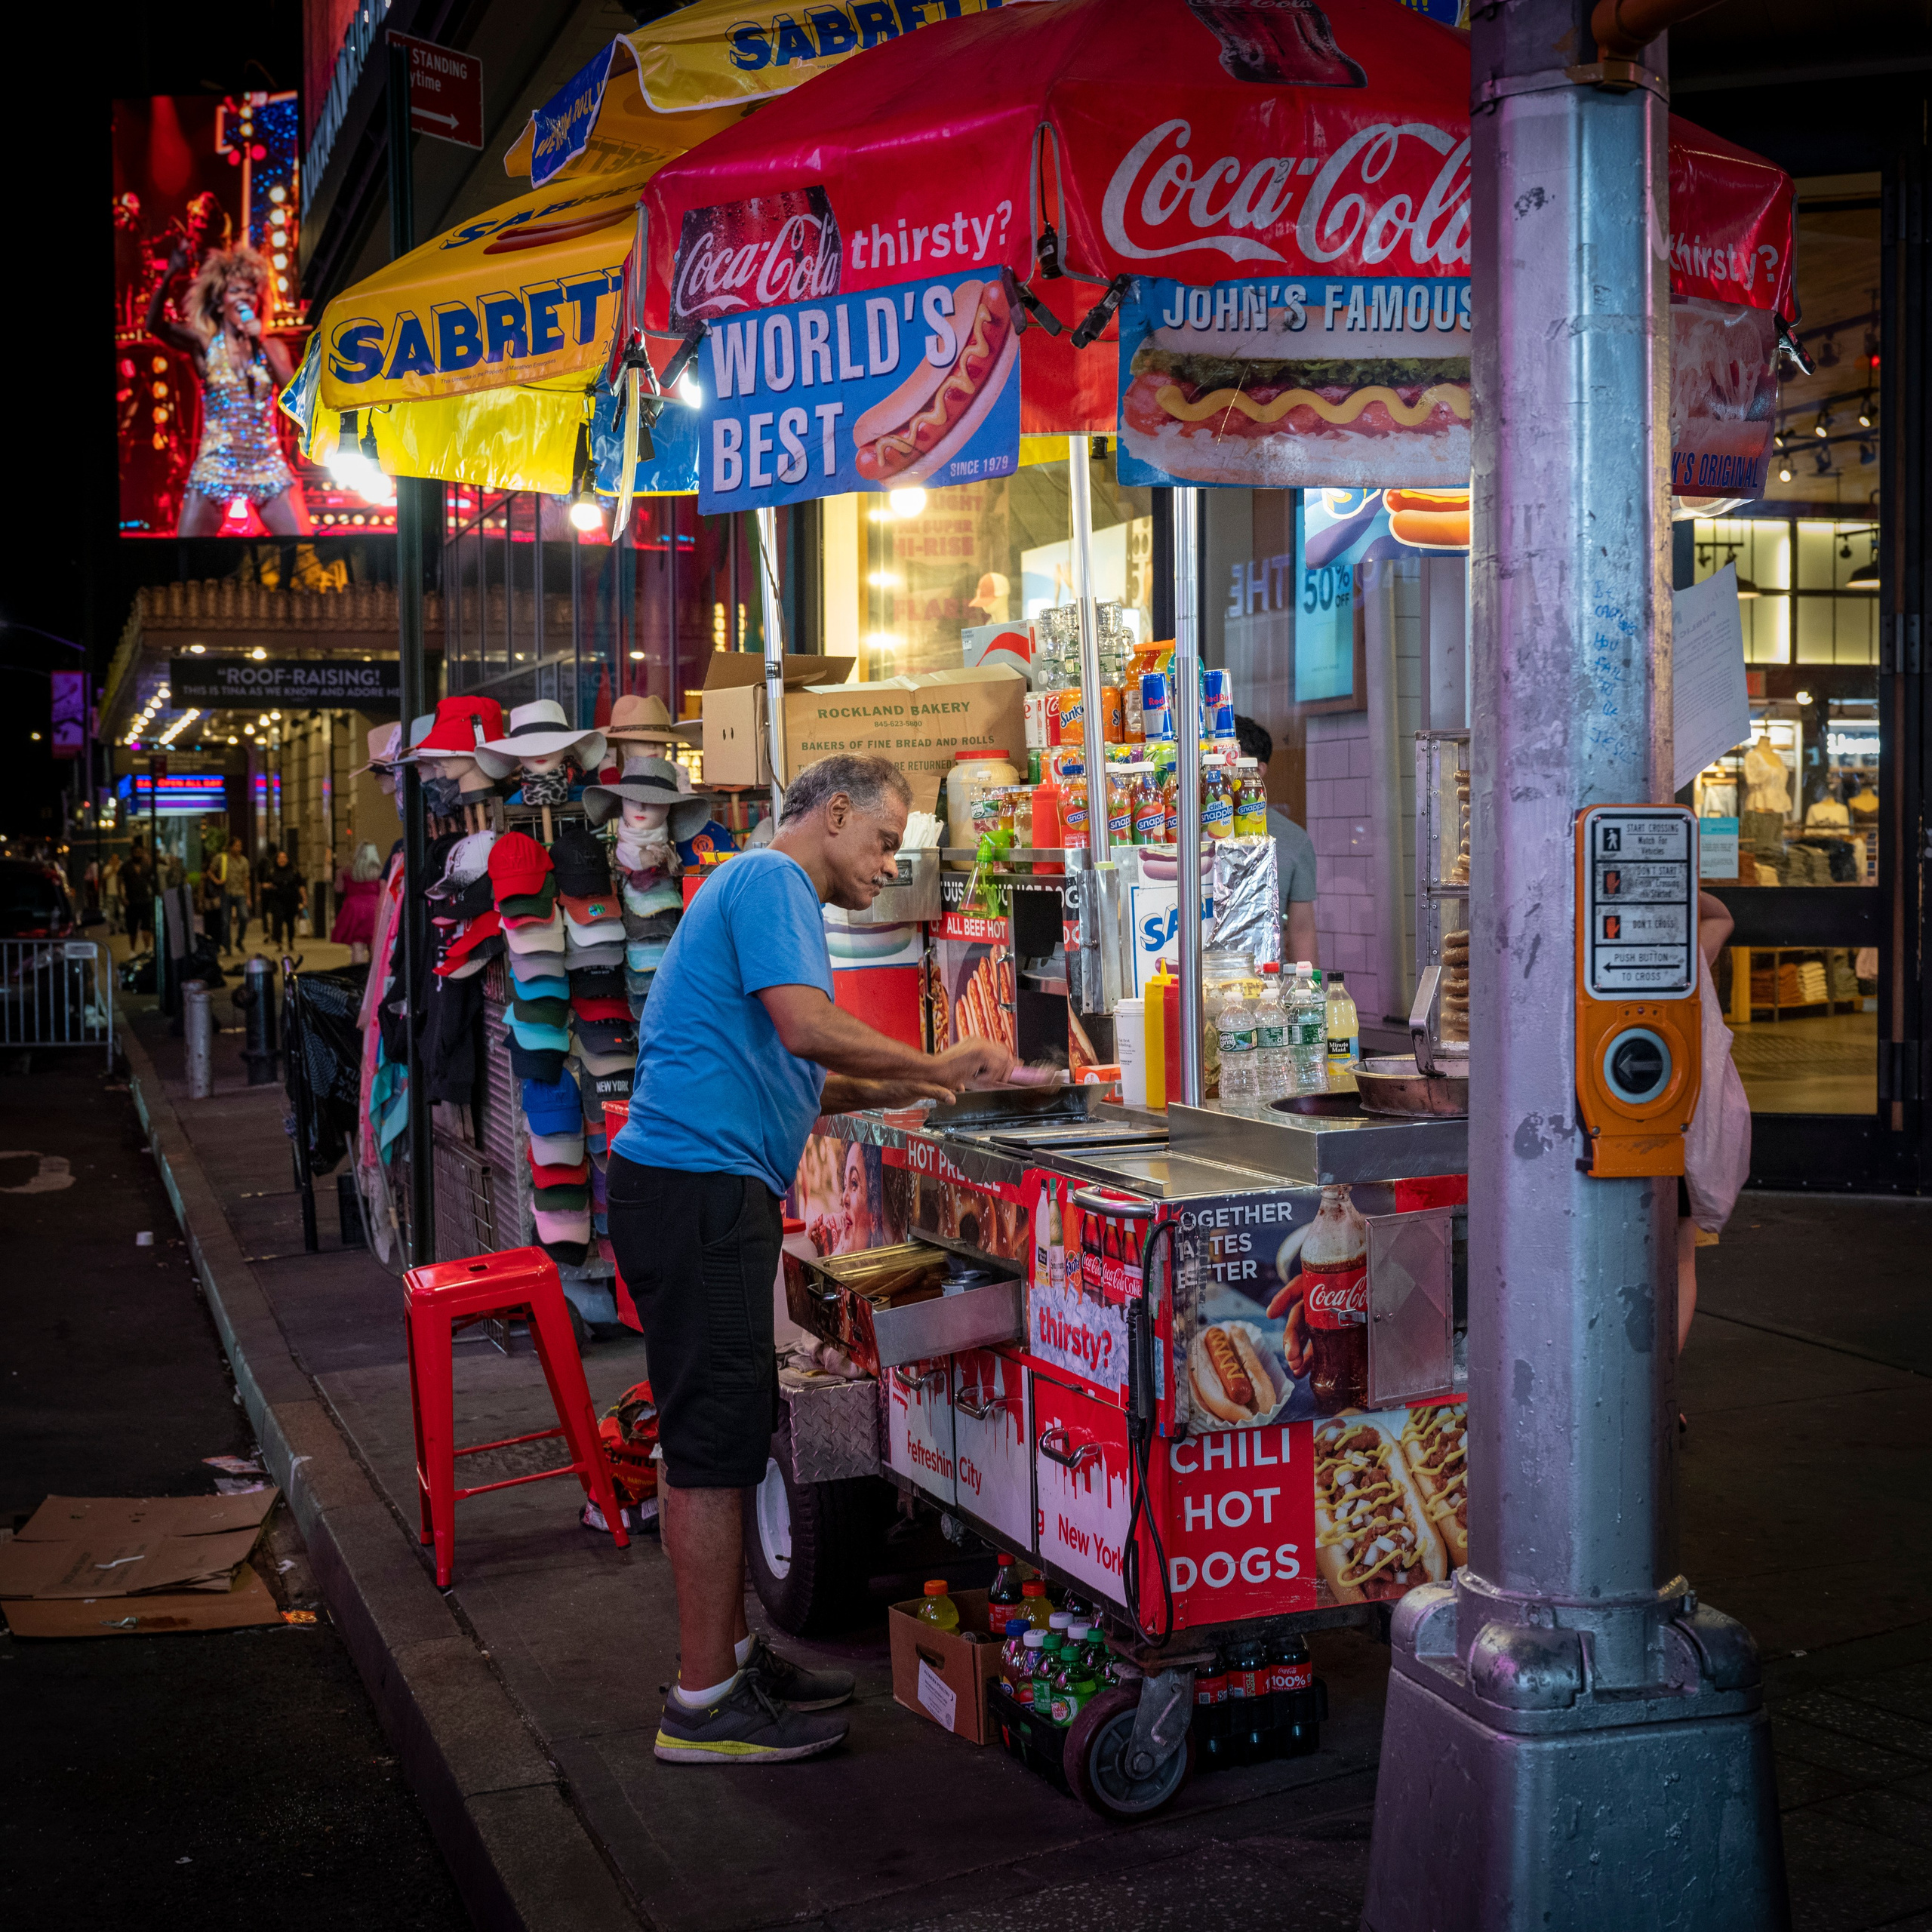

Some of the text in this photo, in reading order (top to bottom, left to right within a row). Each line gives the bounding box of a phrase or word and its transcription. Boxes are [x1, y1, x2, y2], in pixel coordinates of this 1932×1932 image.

[412, 48, 468, 80] STANDING
[410, 69, 441, 92] ytime
[851, 200, 1012, 270] thirsty?
[1669, 232, 1778, 291] thirsty?
[1163, 285, 1308, 332] JOHN'S
[712, 285, 956, 400] WORLD'S
[485, 368, 504, 376] Property
[509, 362, 532, 371] Marathon
[533, 358, 556, 368] Enterprises
[712, 402, 844, 495] BEST
[950, 454, 1009, 478] SINCE 1979
[1699, 453, 1759, 488] ORIGINAL
[1335, 593, 1349, 608] OFF
[817, 701, 971, 719] ROCKLAND BAKERY
[1149, 697, 1164, 706] Red
[874, 720, 922, 728] 845-623-5800
[801, 734, 995, 751] BAKERS OF FINE BREAD AND ROLLS
[908, 759, 952, 771] RETURNED
[1201, 806, 1233, 822] snapple
[1209, 801, 1223, 811] diet
[1239, 801, 1266, 815] snapple
[1627, 824, 1678, 832] START CROSSING
[1659, 866, 1676, 875] START
[946, 916, 963, 934] ALL
[964, 918, 986, 937] BEEF
[987, 920, 1006, 939] HOT
[1614, 953, 1669, 962] PUSH BUTTON
[1622, 972, 1661, 981] TO CROSS
[596, 1081, 629, 1093] NEW YORK
[909, 1140, 935, 1171] HOT
[1103, 1263, 1124, 1291] Coca-Cola
[1124, 1277, 1141, 1297] Coke
[1309, 1275, 1367, 1312] Coca-Co
[1039, 1306, 1113, 1371] thirsty?
[1170, 1428, 1291, 1475] CHILI
[959, 1456, 983, 1496] City
[1183, 1487, 1281, 1533] HOT
[1058, 1512, 1090, 1556] New
[1094, 1532, 1124, 1577] York
[1171, 1544, 1300, 1594] DOGS
[1272, 1675, 1306, 1687] 100%
